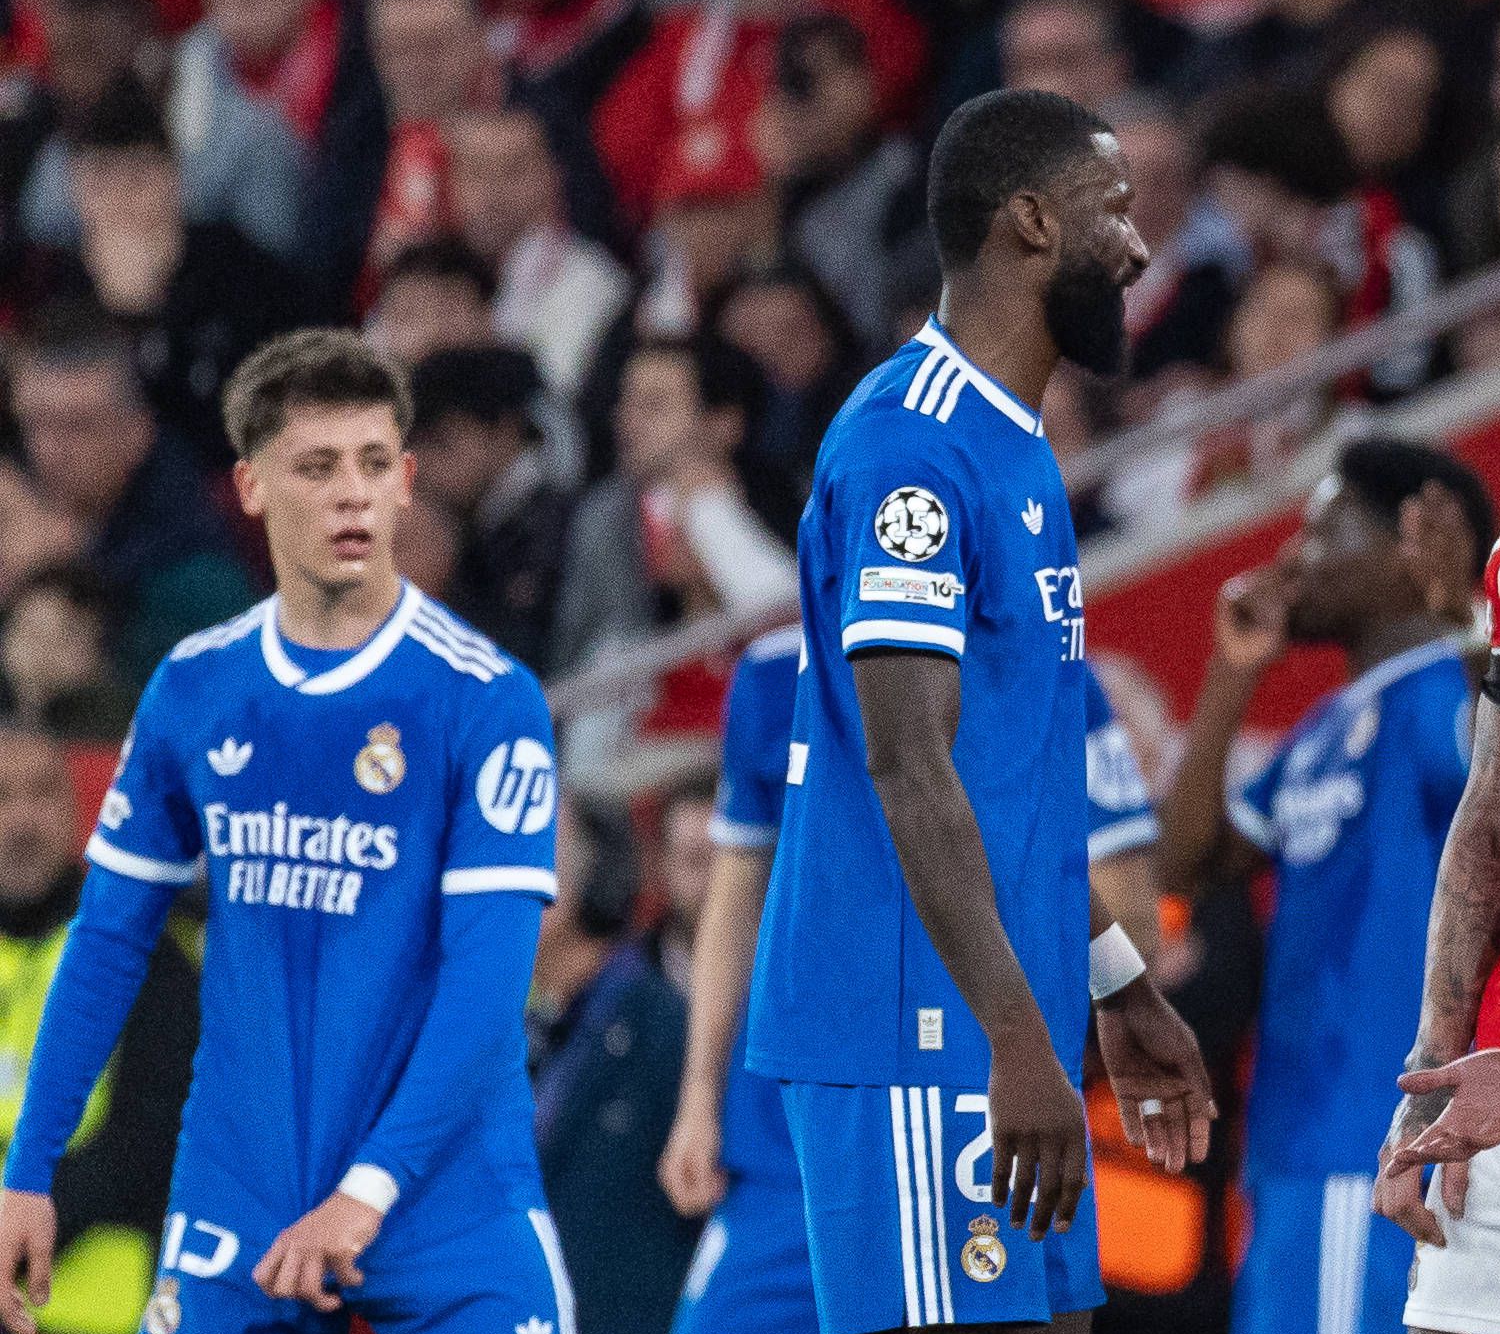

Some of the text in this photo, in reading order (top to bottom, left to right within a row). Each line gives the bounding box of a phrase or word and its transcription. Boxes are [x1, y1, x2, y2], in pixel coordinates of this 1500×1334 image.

[894, 509, 930, 538] 15
[486, 738, 553, 835] hp
[203, 801, 398, 870] Emirates
